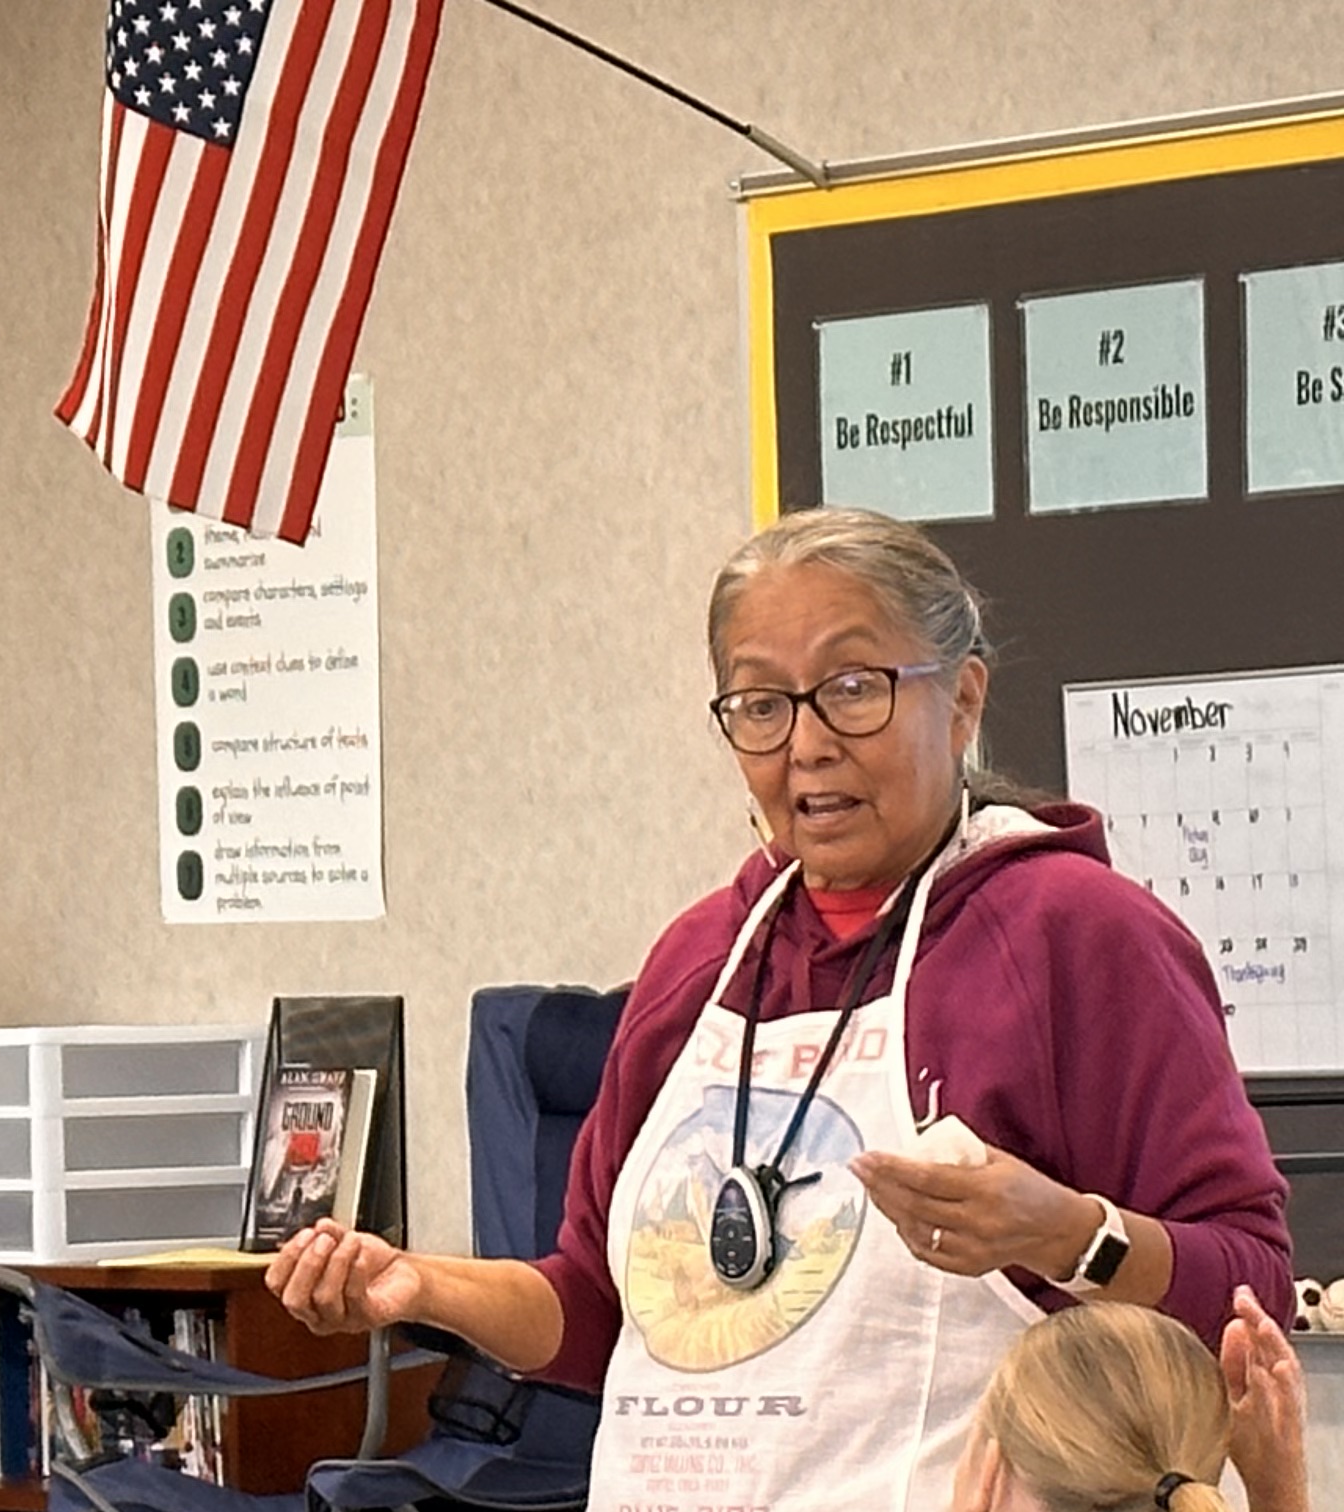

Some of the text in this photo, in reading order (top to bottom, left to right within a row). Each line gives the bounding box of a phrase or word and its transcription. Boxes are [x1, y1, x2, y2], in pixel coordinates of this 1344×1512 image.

[1098, 329, 1125, 367] #2
[889, 352, 913, 387] #1
[1296, 370, 1323, 406] Be
[836, 404, 974, 451] Be Respectful
[1039, 383, 1195, 434] Be Responsible
[1112, 691, 1234, 739] November
[615, 1396, 808, 1416] FLOUR
